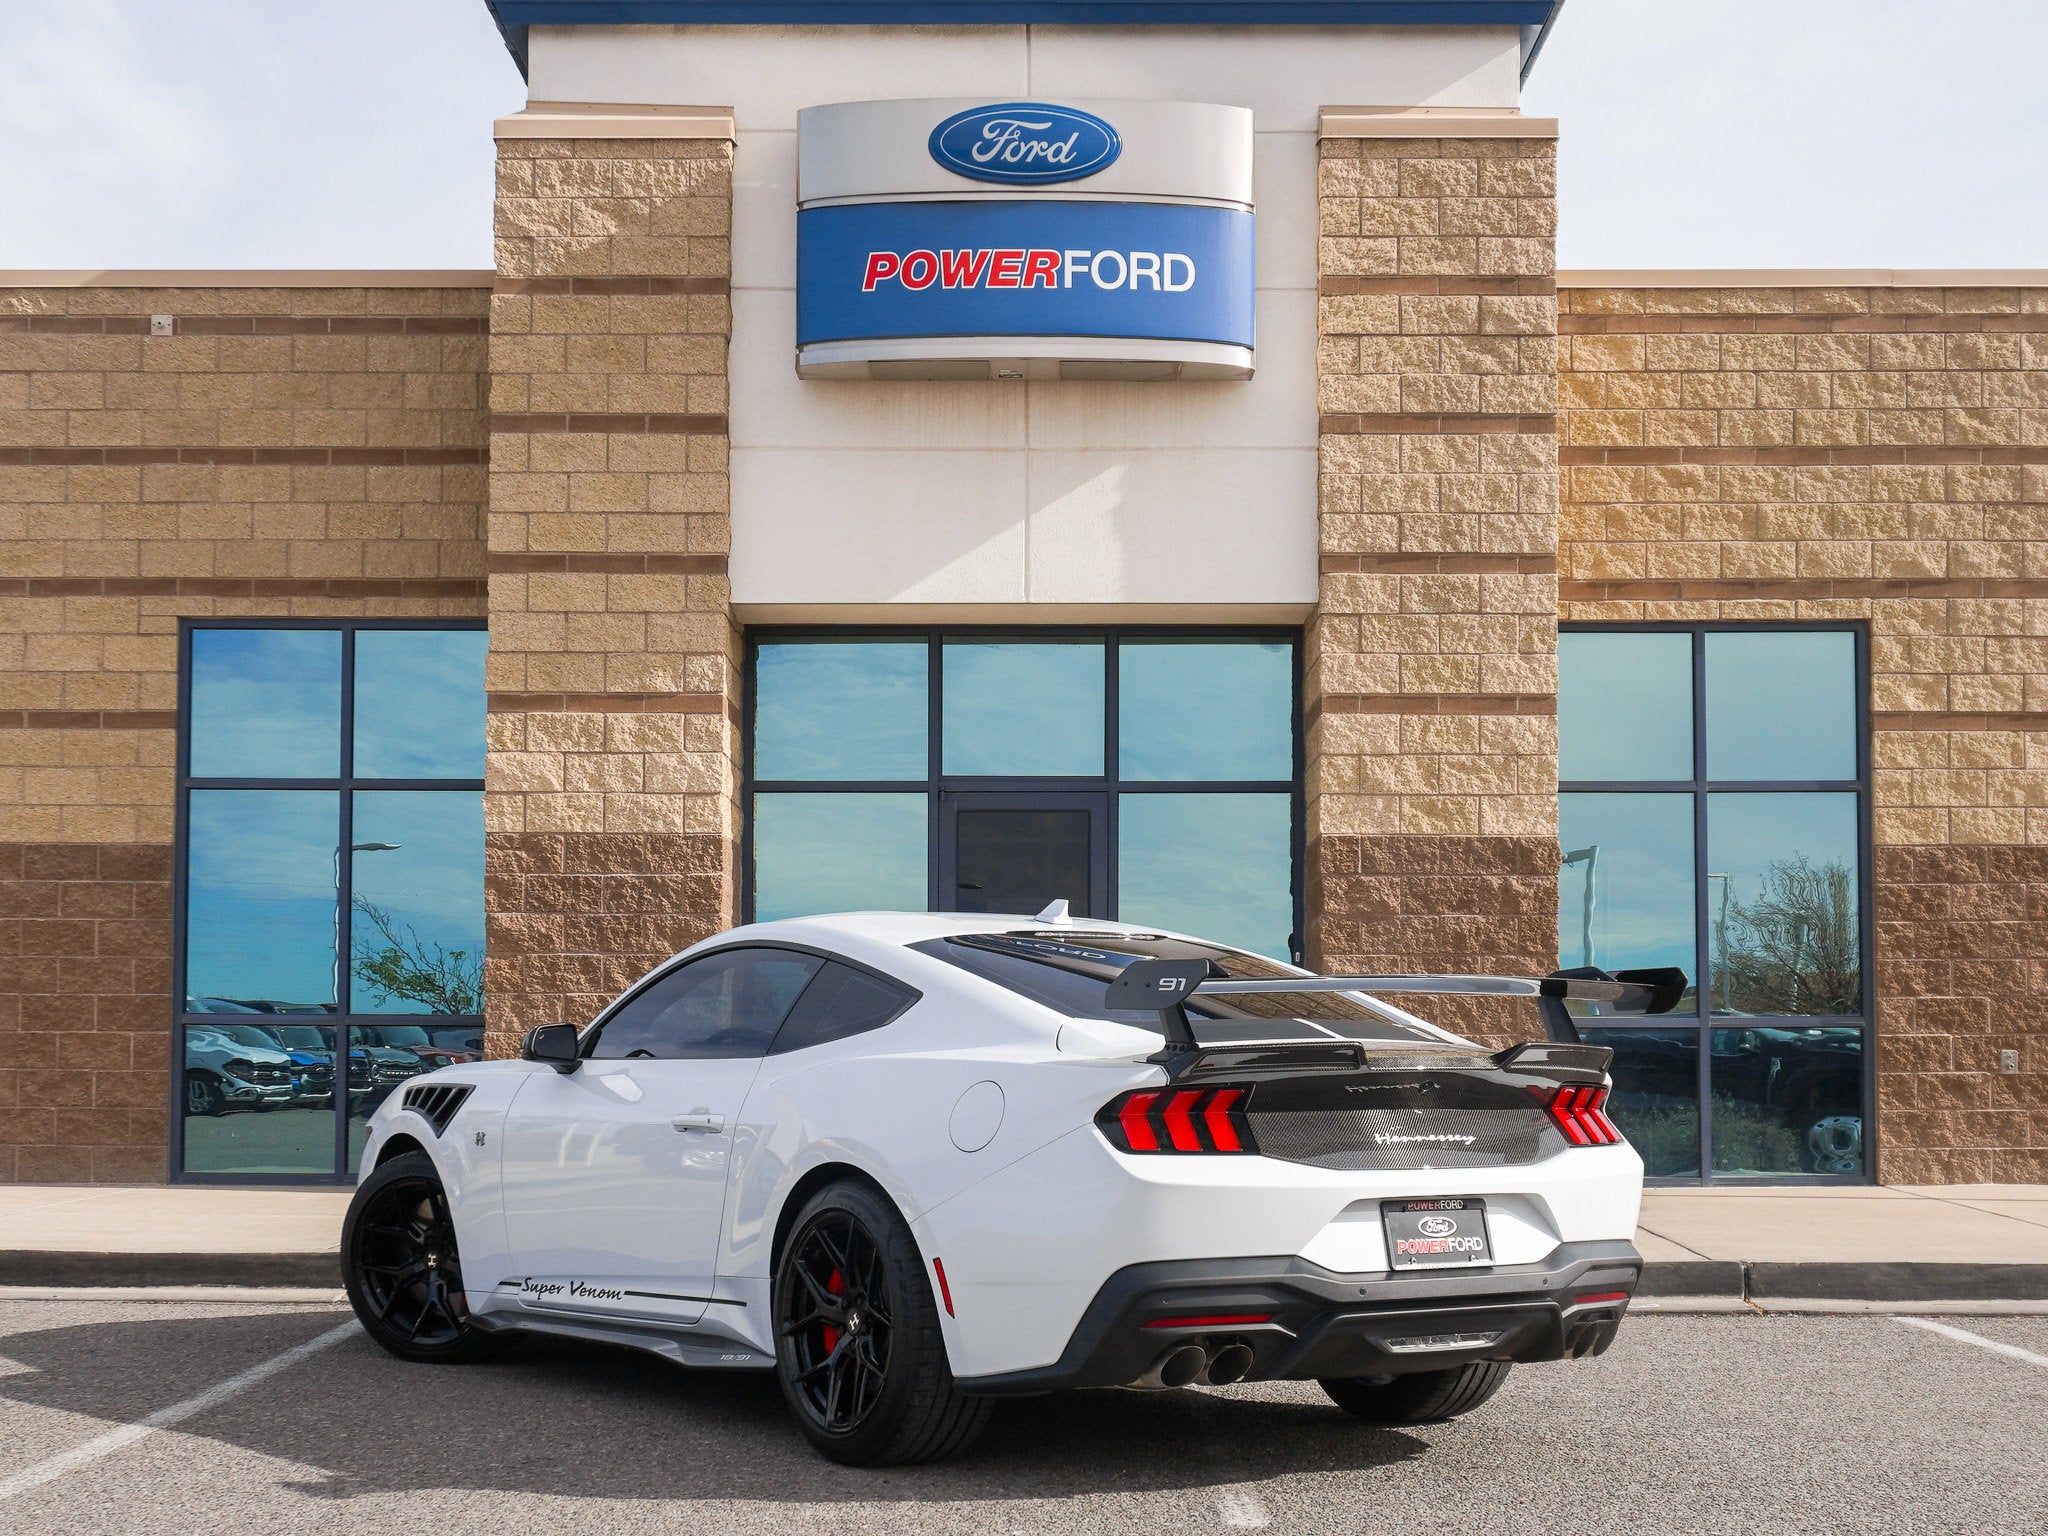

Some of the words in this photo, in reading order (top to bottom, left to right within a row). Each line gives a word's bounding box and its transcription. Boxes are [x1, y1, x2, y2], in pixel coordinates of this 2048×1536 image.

[971, 119, 1080, 164] Ford
[862, 249, 1196, 292] POWERFORD
[1158, 977, 1187, 991] 91
[1407, 1200, 1464, 1211] POWERFORD
[1426, 1219, 1450, 1233] Ford
[1396, 1236, 1484, 1255] POWERFORD
[521, 1277, 565, 1300] Super
[570, 1280, 622, 1300] Venom
